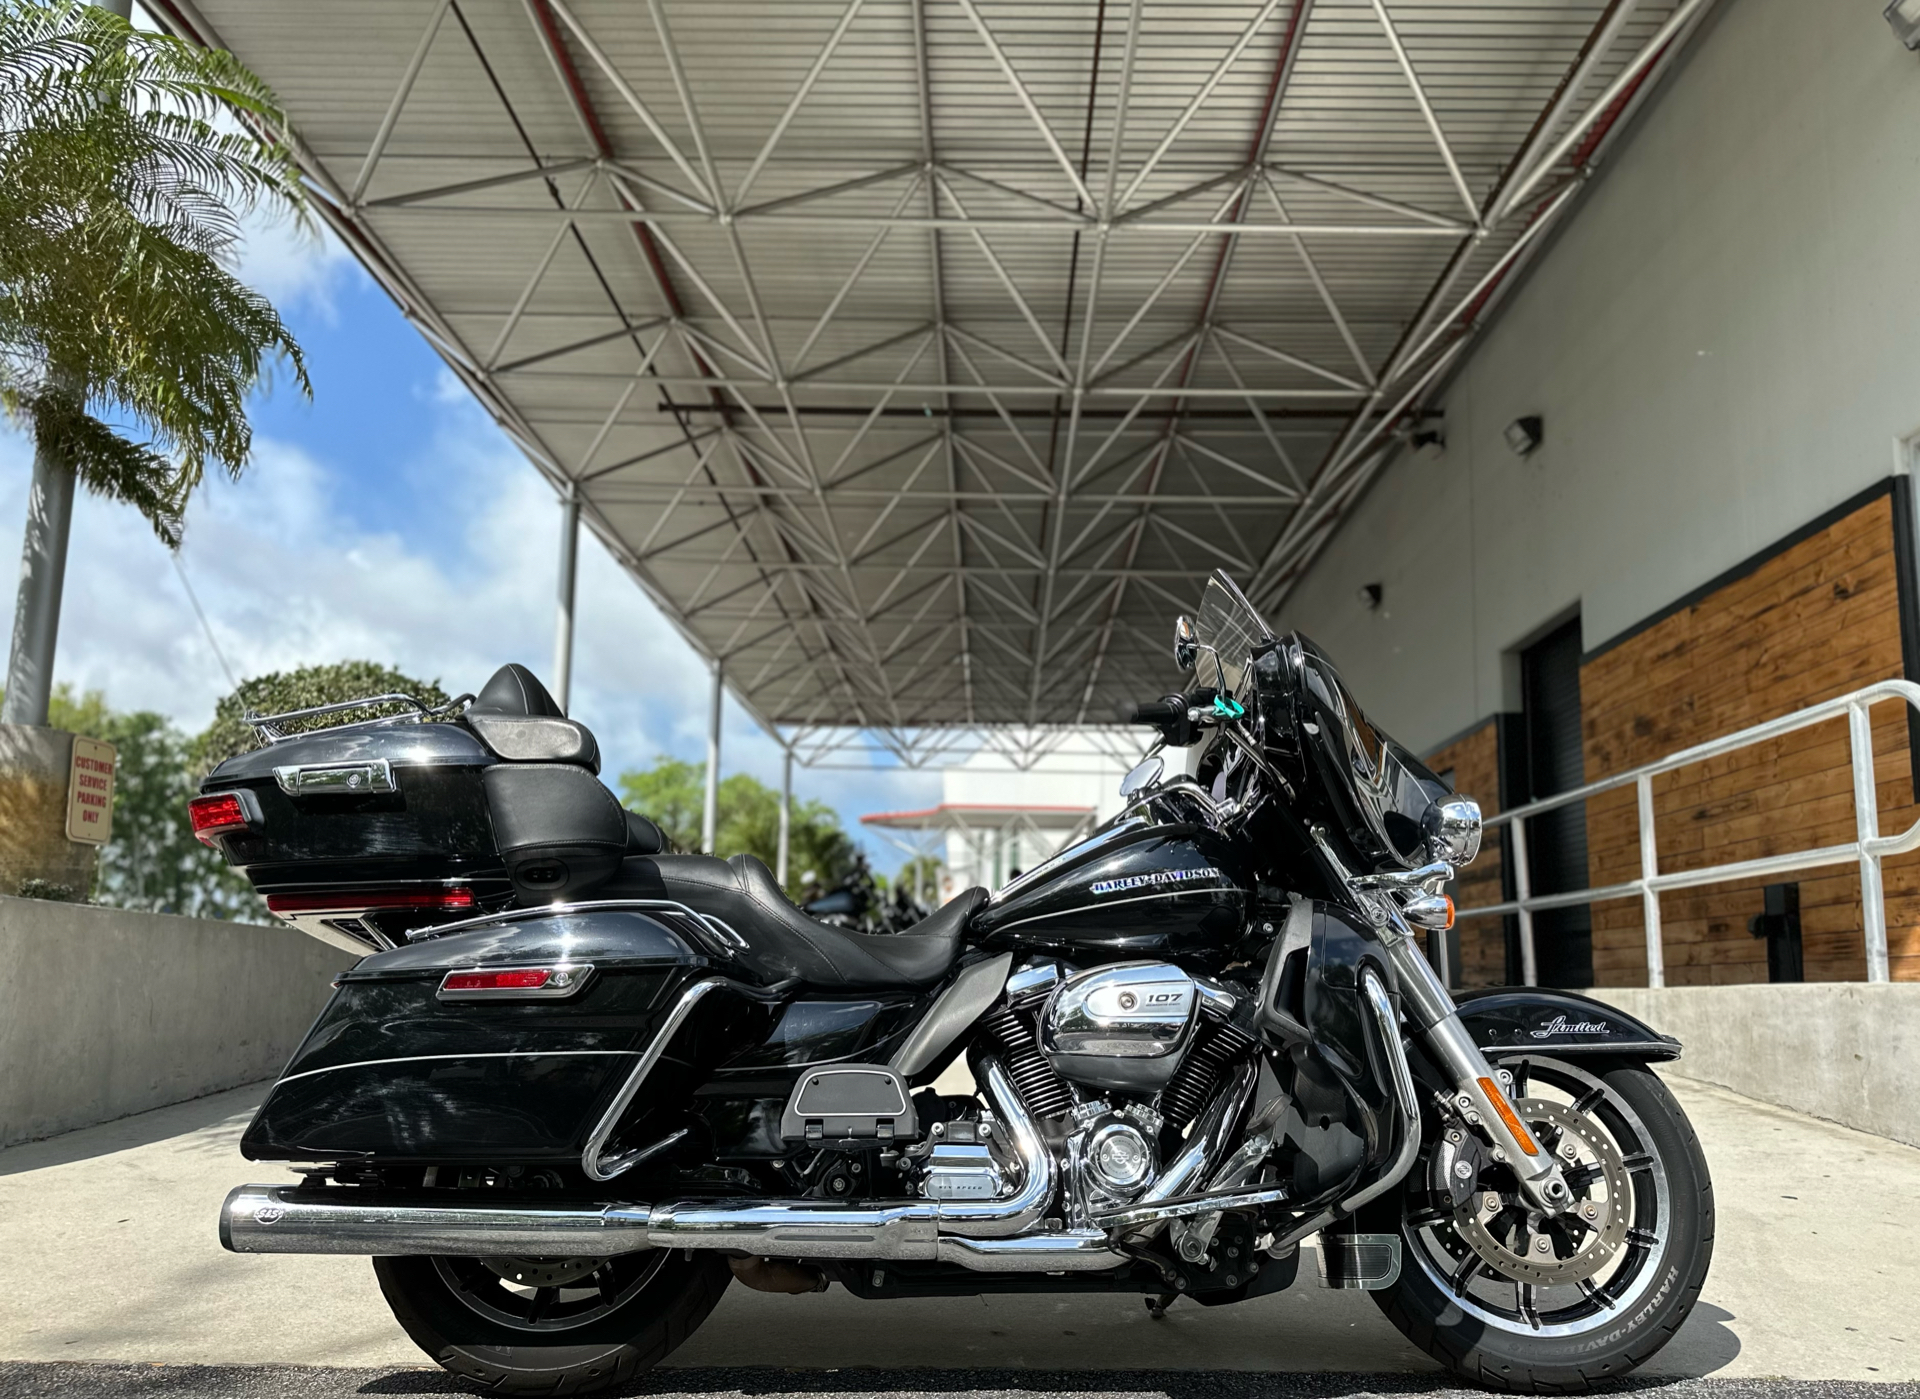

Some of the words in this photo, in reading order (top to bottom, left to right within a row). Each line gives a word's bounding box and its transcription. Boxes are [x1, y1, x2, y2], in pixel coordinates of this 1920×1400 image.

[75, 756, 112, 774] CUSTOMER
[79, 774, 107, 790] SERVICE
[77, 791, 107, 808] PARKING
[82, 809, 99, 824] ONLY
[1148, 993, 1183, 1003] 107
[1530, 1015, 1610, 1038] Limited
